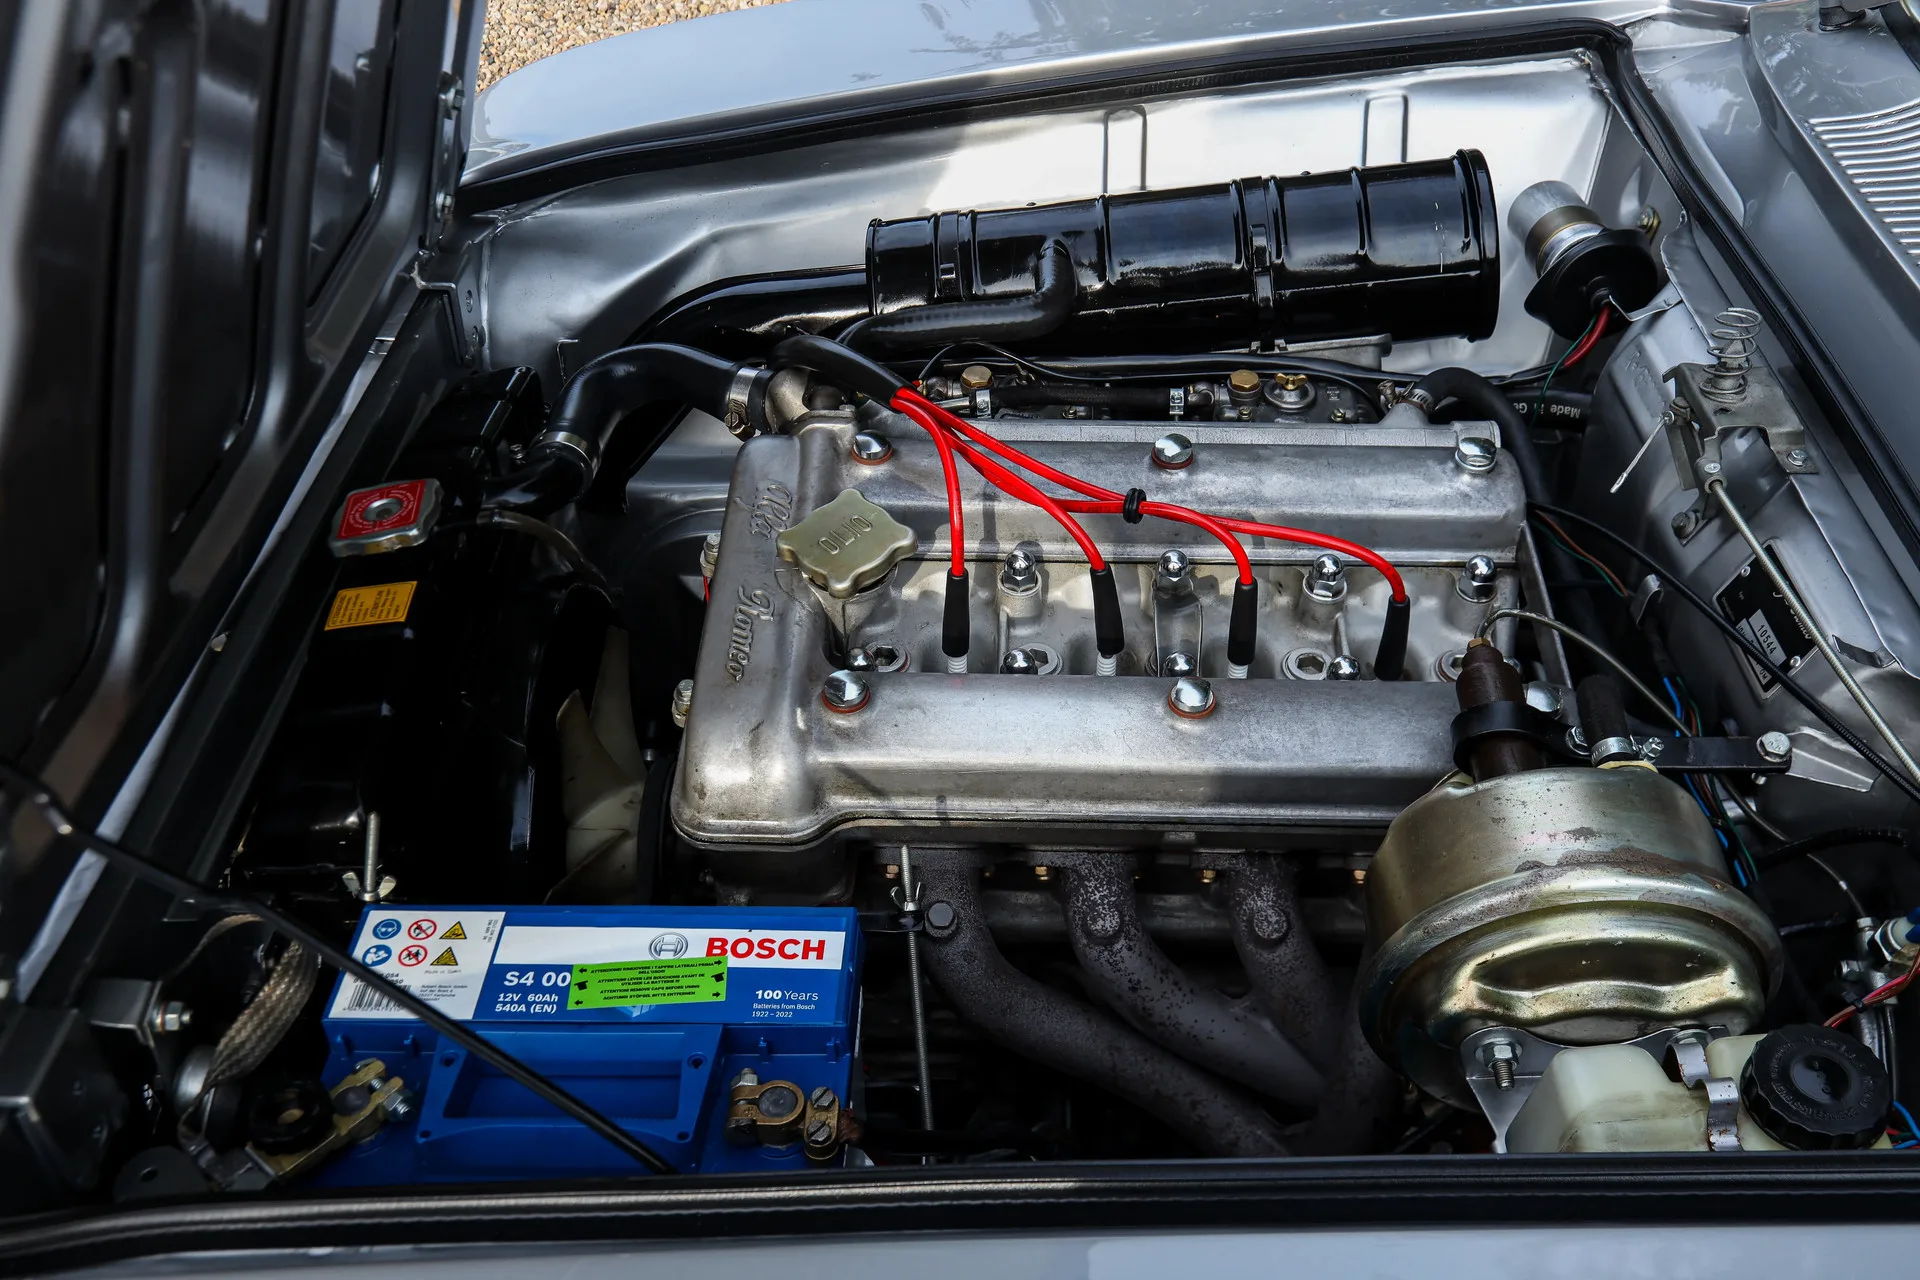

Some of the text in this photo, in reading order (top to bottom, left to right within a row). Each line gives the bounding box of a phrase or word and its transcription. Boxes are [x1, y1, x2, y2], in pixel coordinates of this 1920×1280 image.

[1550, 404, 1581, 419] Made
[733, 478, 793, 539] Alfa
[818, 514, 873, 555] OLIO
[725, 583, 775, 682] Romeo
[1757, 624, 1777, 655] 10544
[705, 937, 826, 960] BOSCH
[503, 970, 535, 987] S4
[497, 992, 559, 1002] 12V 60Ah
[755, 989, 819, 1001] 100 Years
[494, 1003, 557, 1014] 540A (EN)
[751, 1010, 769, 1018] 1922
[752, 1002, 781, 1010] Batteries
[781, 1002, 796, 1010] from
